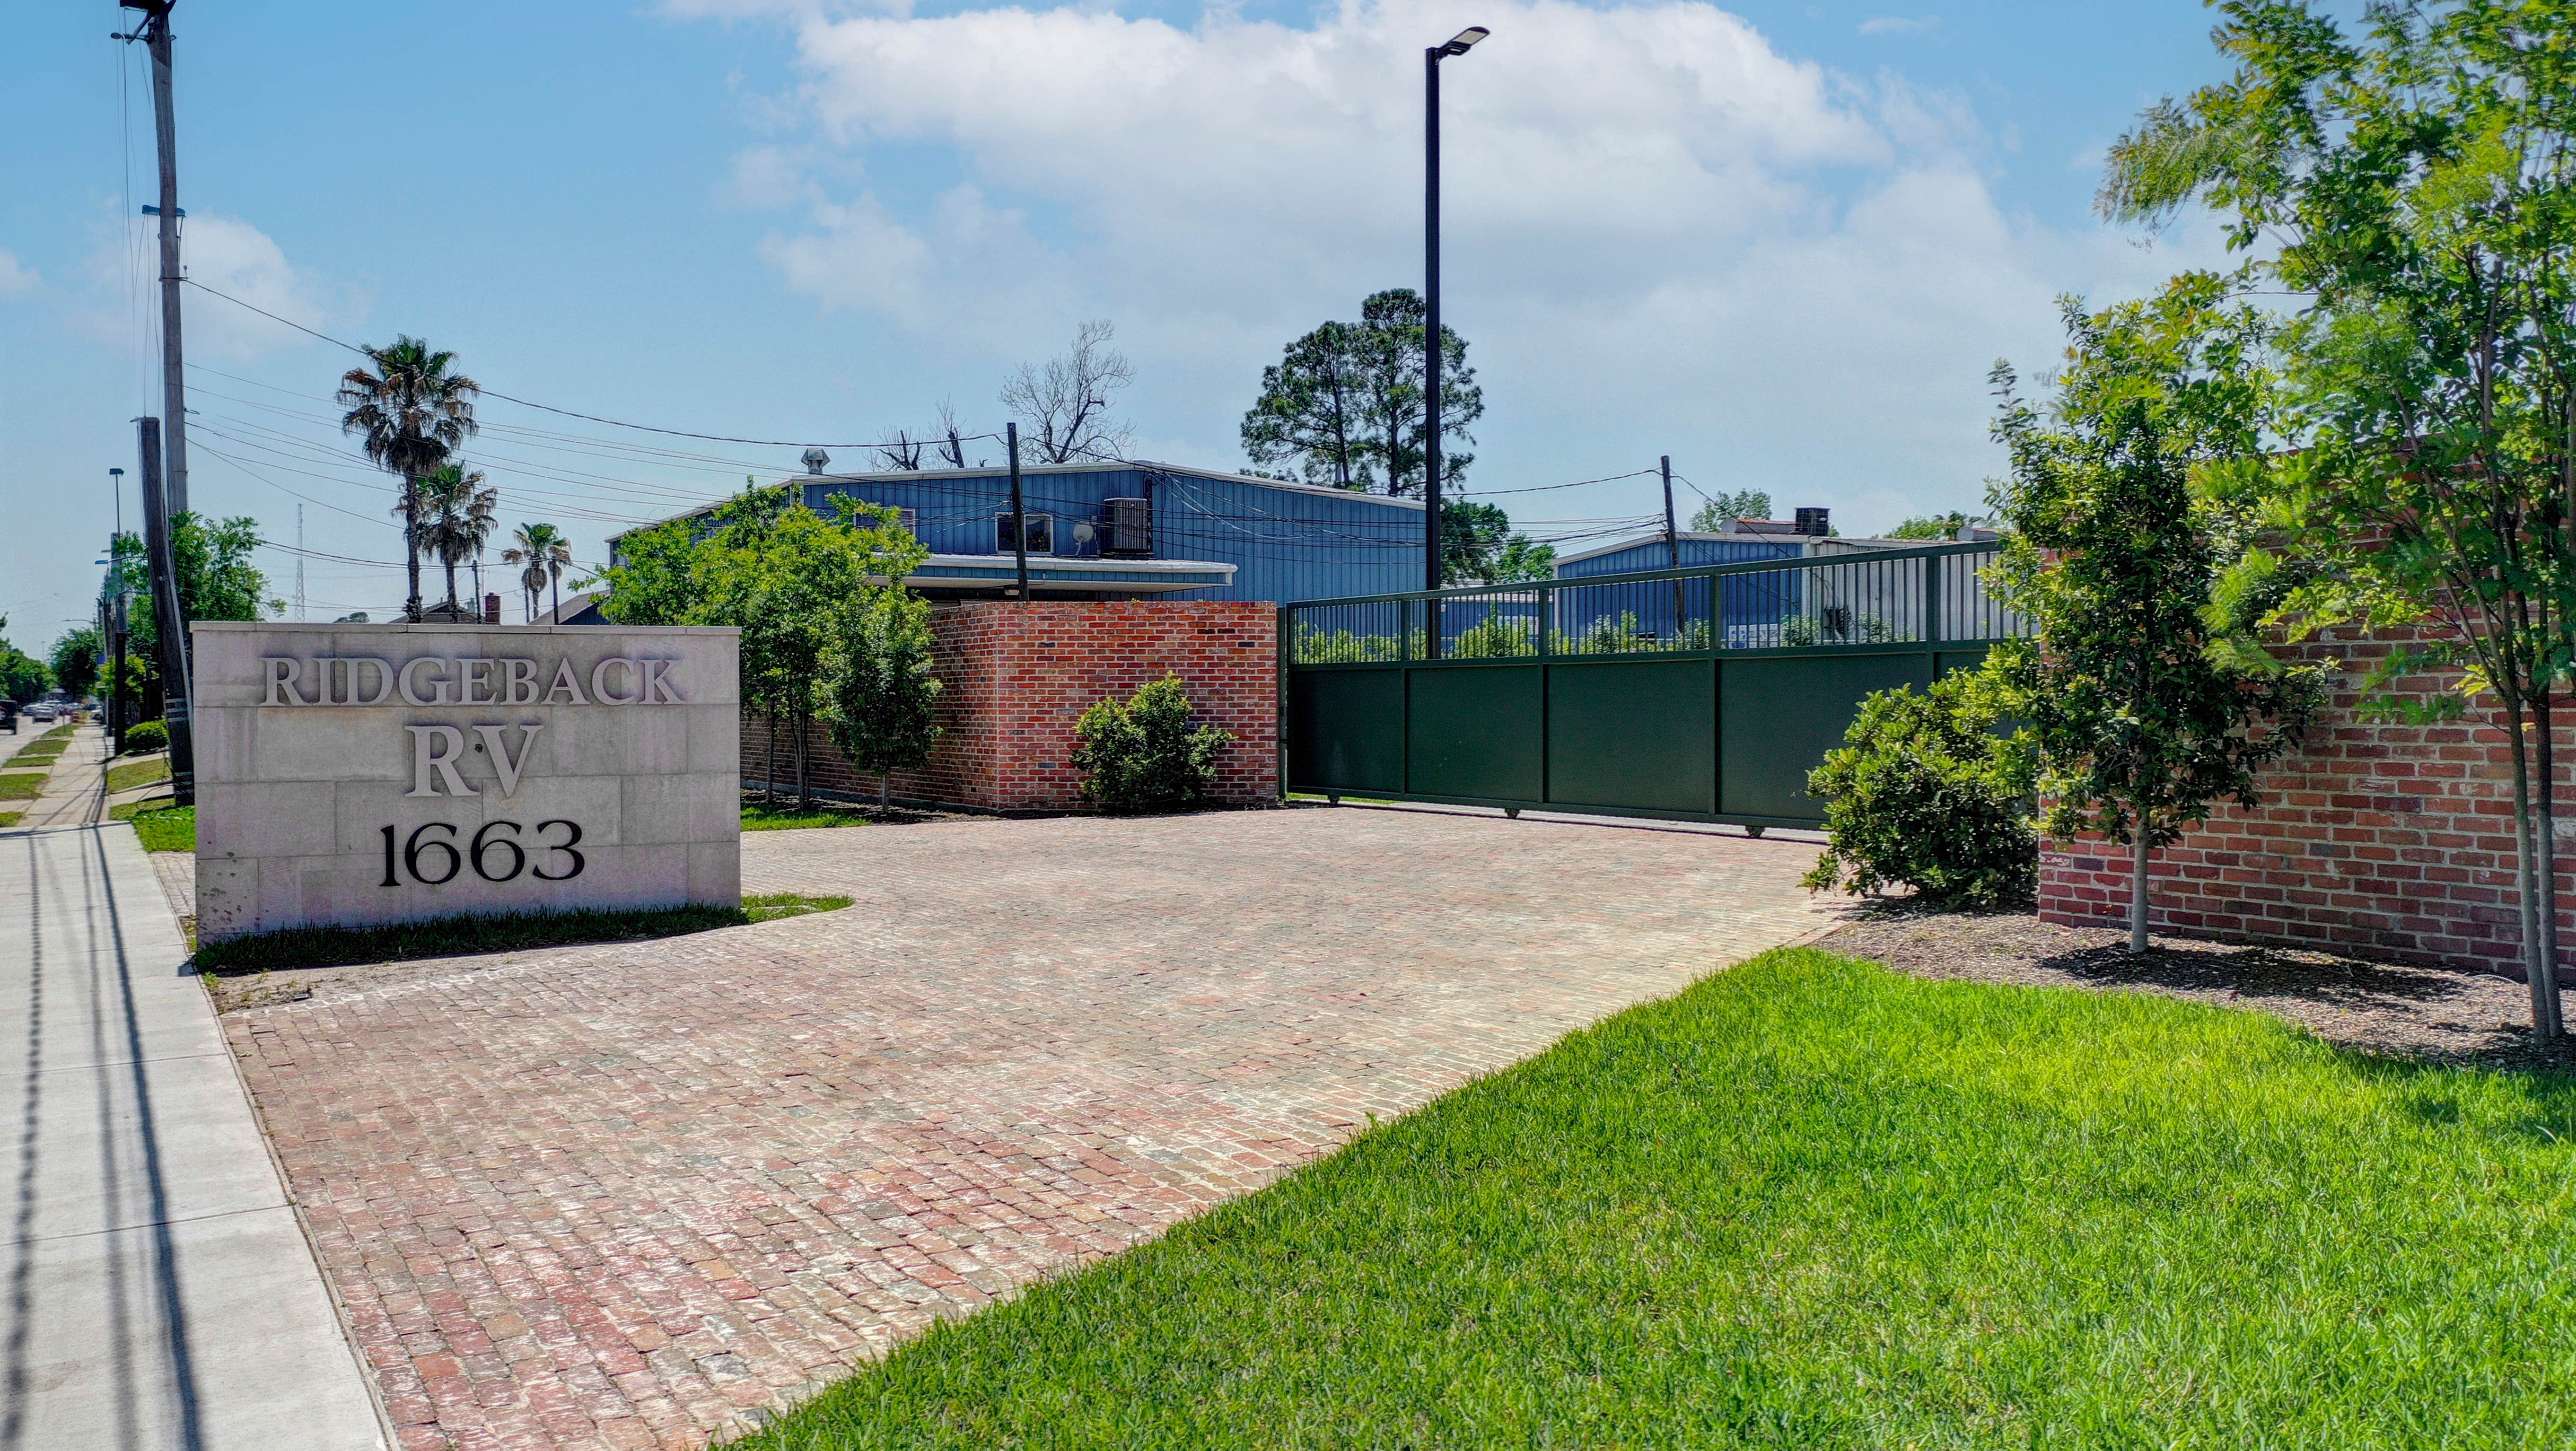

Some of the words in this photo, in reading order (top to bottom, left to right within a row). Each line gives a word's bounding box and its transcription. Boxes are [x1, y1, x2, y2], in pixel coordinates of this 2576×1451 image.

[260, 657, 686, 706] RIDGEBACK
[404, 725, 543, 797] RV
[379, 820, 585, 887] 1663
